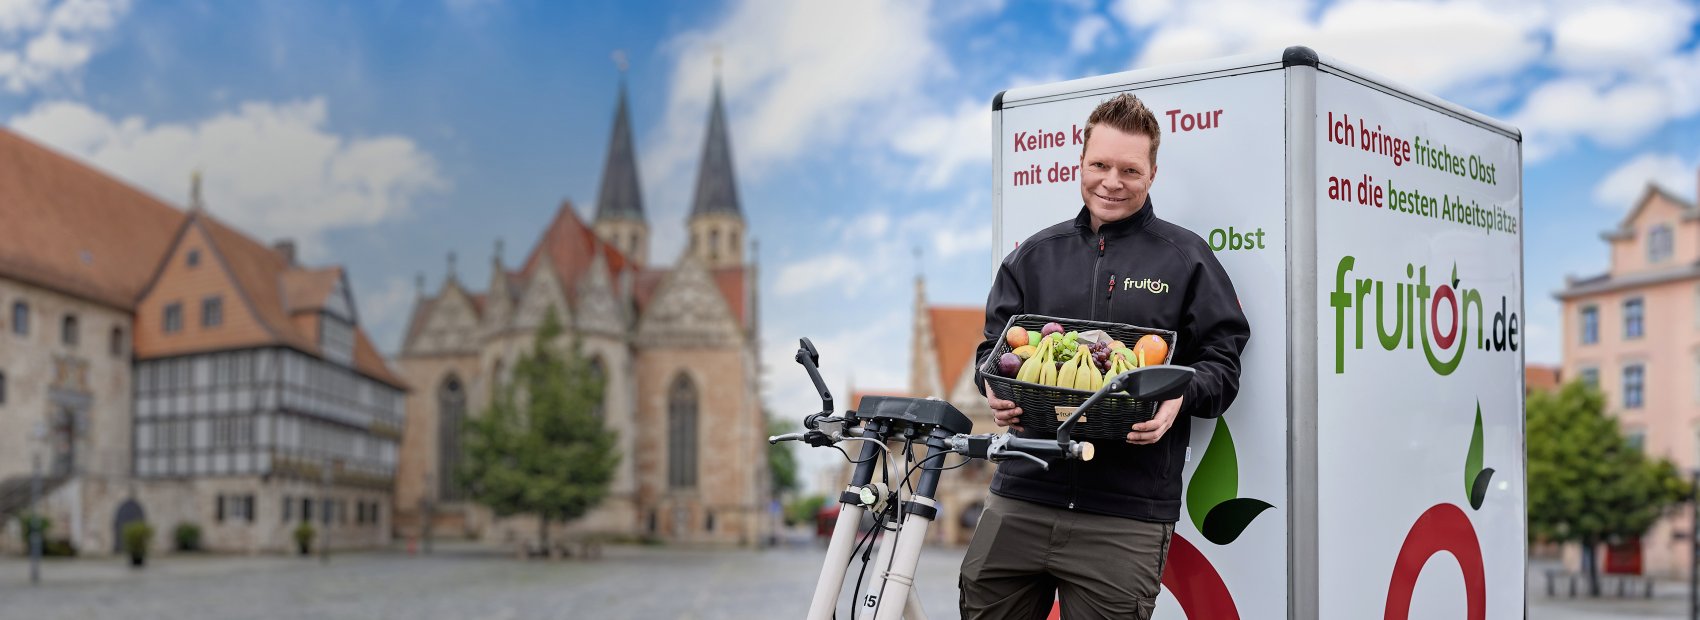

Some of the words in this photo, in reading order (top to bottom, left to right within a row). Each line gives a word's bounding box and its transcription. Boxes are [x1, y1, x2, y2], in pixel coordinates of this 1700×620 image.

[1014, 129, 1065, 152] Keine
[1166, 109, 1223, 133] Tour
[1328, 112, 1355, 147] Ich
[1360, 118, 1411, 166] bringe
[1414, 136, 1466, 177] frisches
[1469, 155, 1497, 186] Obst
[1014, 164, 1042, 186] mit
[1047, 162, 1080, 183] der
[1328, 176, 1352, 202] an
[1357, 174, 1383, 208] die
[1388, 180, 1438, 218] besten
[1442, 194, 1517, 235] Arbeitsplätze
[1209, 226, 1266, 252] Obst
[1124, 278, 1169, 293] fruiton
[1330, 255, 1518, 376] fruiton.de
[863, 594, 877, 607] 15
